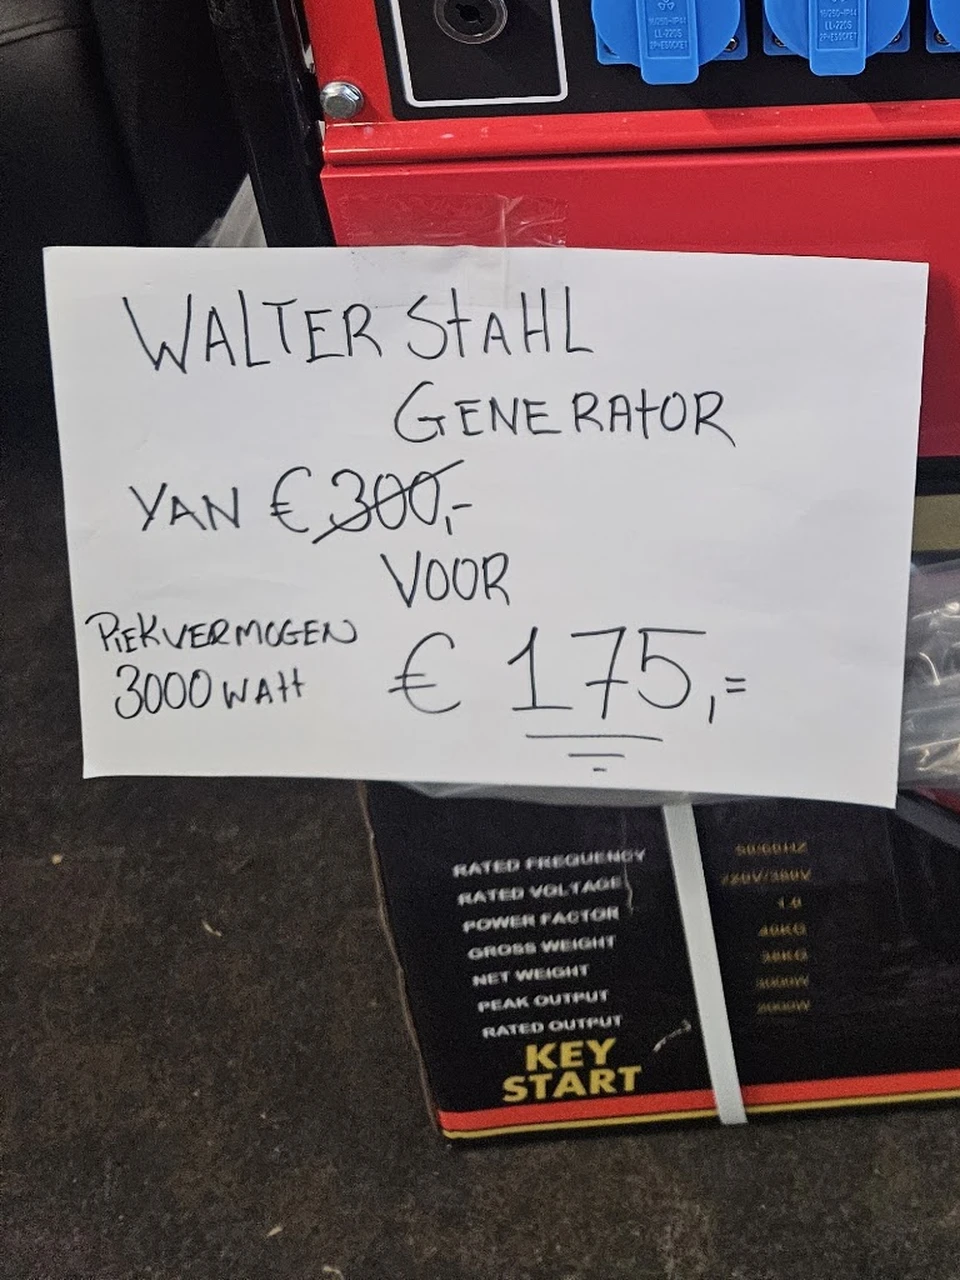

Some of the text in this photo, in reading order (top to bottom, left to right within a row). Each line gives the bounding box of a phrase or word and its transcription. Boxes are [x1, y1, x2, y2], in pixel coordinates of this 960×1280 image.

[122, 290, 383, 374] WALTER
[381, 550, 510, 608] VOOR
[115, 664, 212, 719] 3000
[453, 848, 646, 878] RATED FREQUENCY
[457, 875, 622, 906] RATED VOLTAGE
[462, 905, 620, 934] POWER FACTOR
[467, 934, 617, 961] GROSS WEIGHT
[472, 963, 590, 987] NET WEIGHT
[477, 989, 609, 1013] PEAK OUTPUT
[482, 1014, 622, 1039] RATED OUTPUT
[526, 1037, 617, 1071] KEY
[502, 1065, 642, 1103] START
